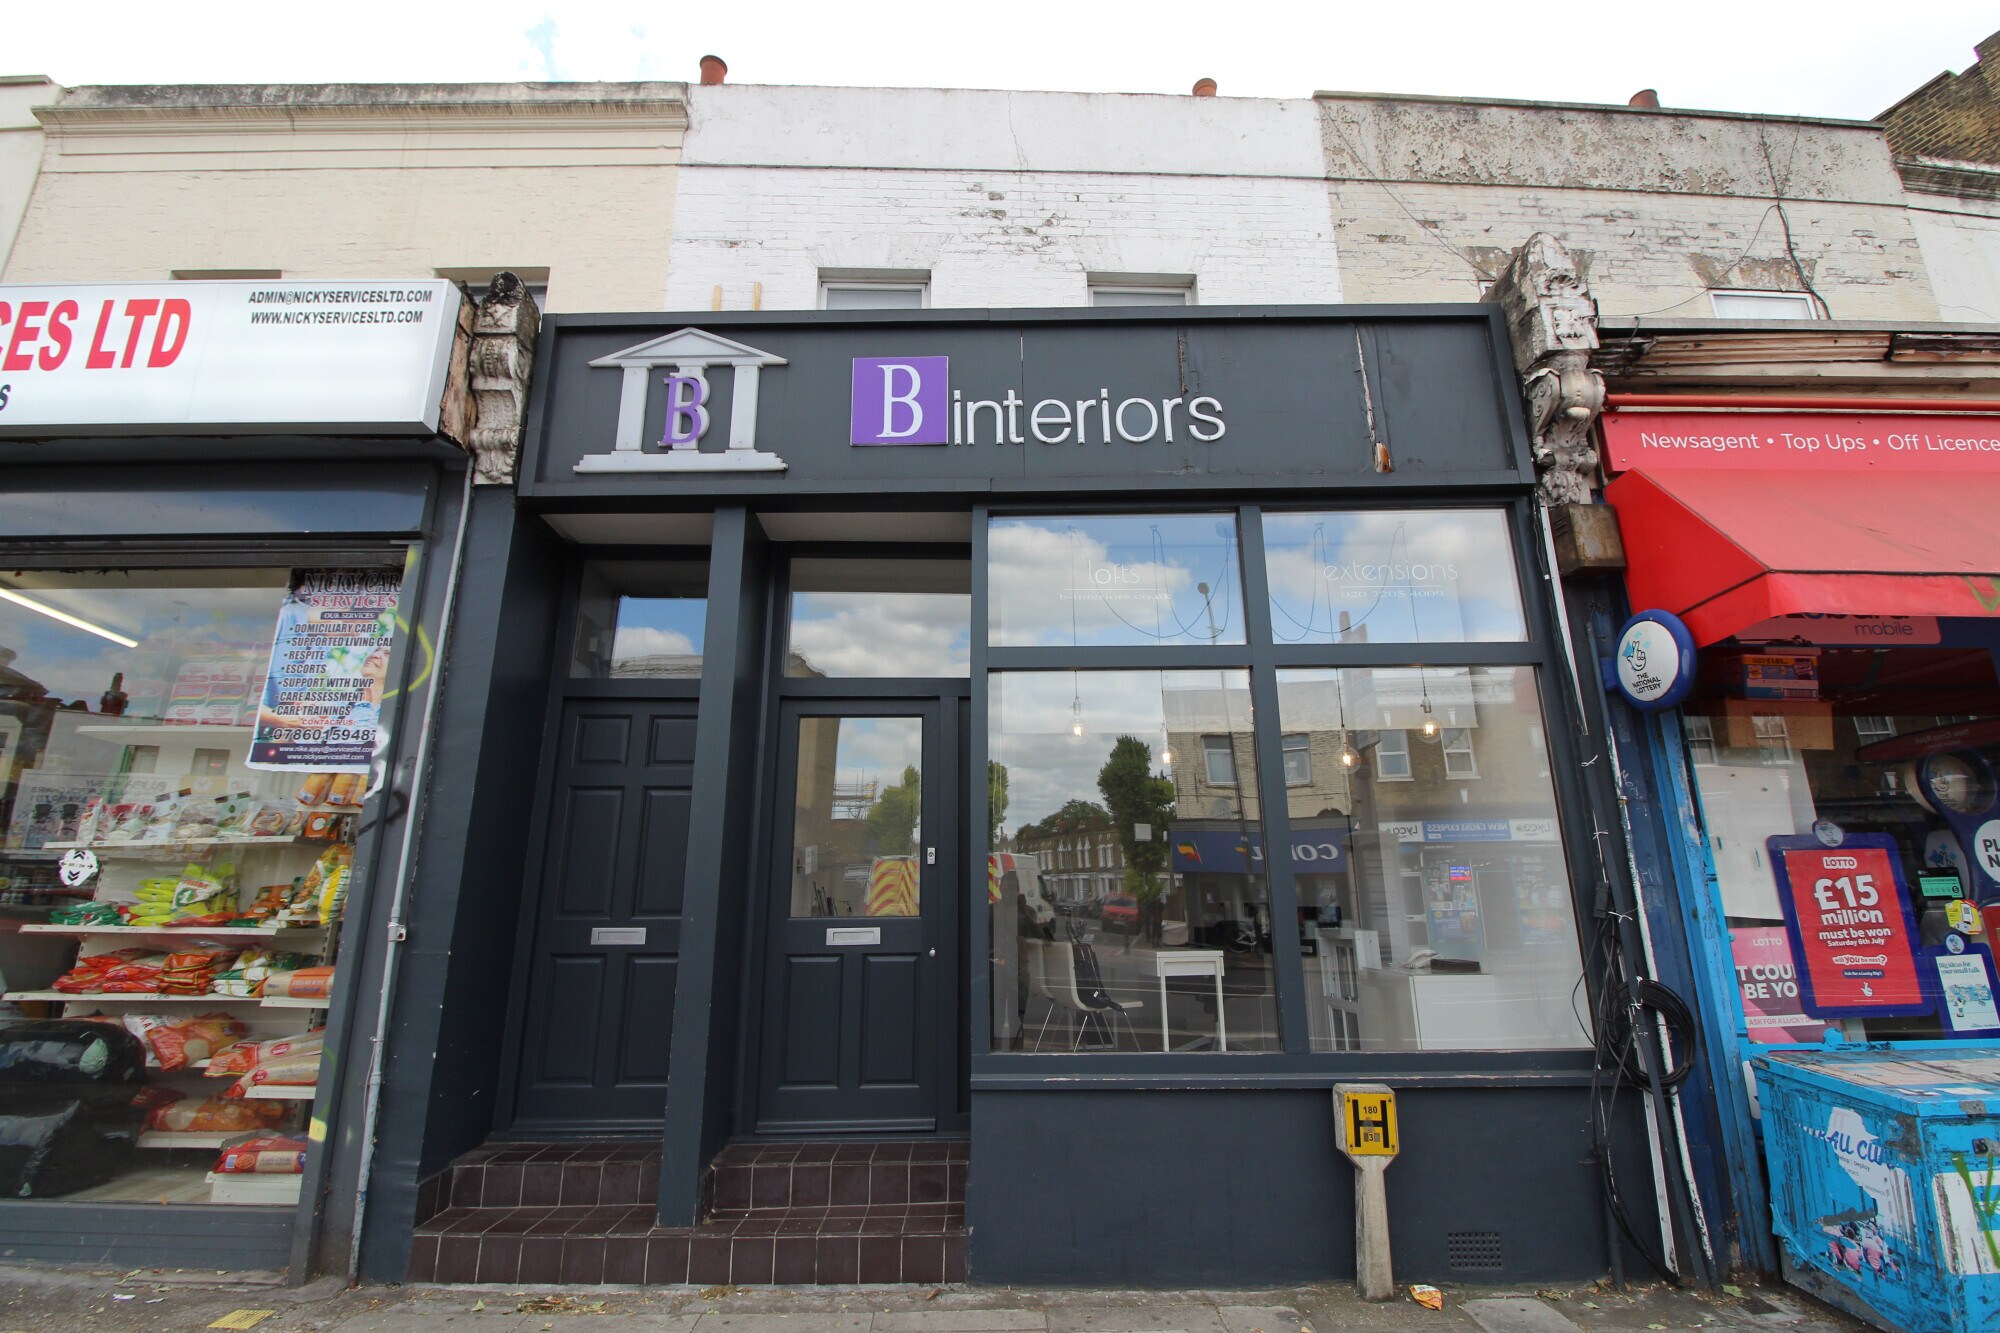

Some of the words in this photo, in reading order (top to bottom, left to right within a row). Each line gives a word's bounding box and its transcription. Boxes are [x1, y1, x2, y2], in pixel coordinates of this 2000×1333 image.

[249, 290, 432, 304] ADMIN@NICKYSERVICESLTD.COM
[251, 310, 424, 324] WWW.NICKYSERVICESLTD.COM
[85, 298, 191, 369] LTD
[953, 388, 1226, 446] interiors
[1641, 432, 1761, 451] Newsagent
[1781, 433, 1819, 451] Top
[1825, 433, 1866, 452] Ups
[1887, 433, 1919, 451] Off
[1924, 434, 2000, 451] Licence
[1088, 560, 1139, 585] lofts
[1323, 558, 1458, 582] extensions
[303, 572, 362, 595] NICKY
[1340, 590, 1367, 598] 020
[310, 594, 397, 609] SERVICES
[294, 623, 353, 634] DOMICILIARY
[355, 623, 377, 633] CARE
[1854, 621, 1913, 636] mobile
[291, 637, 344, 647] SUPPORTED
[345, 637, 375, 647] LIVING
[288, 651, 325, 660] RESPITE
[285, 664, 327, 674] ESCORTS
[1631, 676, 1662, 688] NATIONAL
[1636, 672, 1649, 680] THE
[282, 678, 325, 688] SUPPORT
[326, 678, 351, 688] WITH
[352, 678, 374, 688] DWP
[1635, 682, 1661, 694] LOTTERY
[279, 691, 304, 702] CARE
[305, 691, 364, 702] ASSESSMENT
[276, 705, 301, 716] CARE
[302, 705, 351, 716] TRAININGS
[301, 718, 340, 726] CONTACT
[1824, 858, 1856, 868] LOTTO
[1813, 875, 1879, 910] £15
[1821, 909, 1883, 926] million
[1819, 929, 1849, 941] must
[1849, 927, 1865, 939] be
[1866, 927, 1891, 937] won
[1753, 937, 1782, 947] LOTTO
[1827, 938, 1857, 947] Saturday
[1857, 937, 1870, 946] 6th
[1870, 937, 1885, 946] July
[1844, 955, 1860, 964] you
[1744, 983, 1770, 999] BE
[1749, 1018, 1763, 1026] ASK
[1763, 1017, 1777, 1025] FOR
[1363, 1106, 1378, 1115] 180
[1351, 1099, 1390, 1149] H
